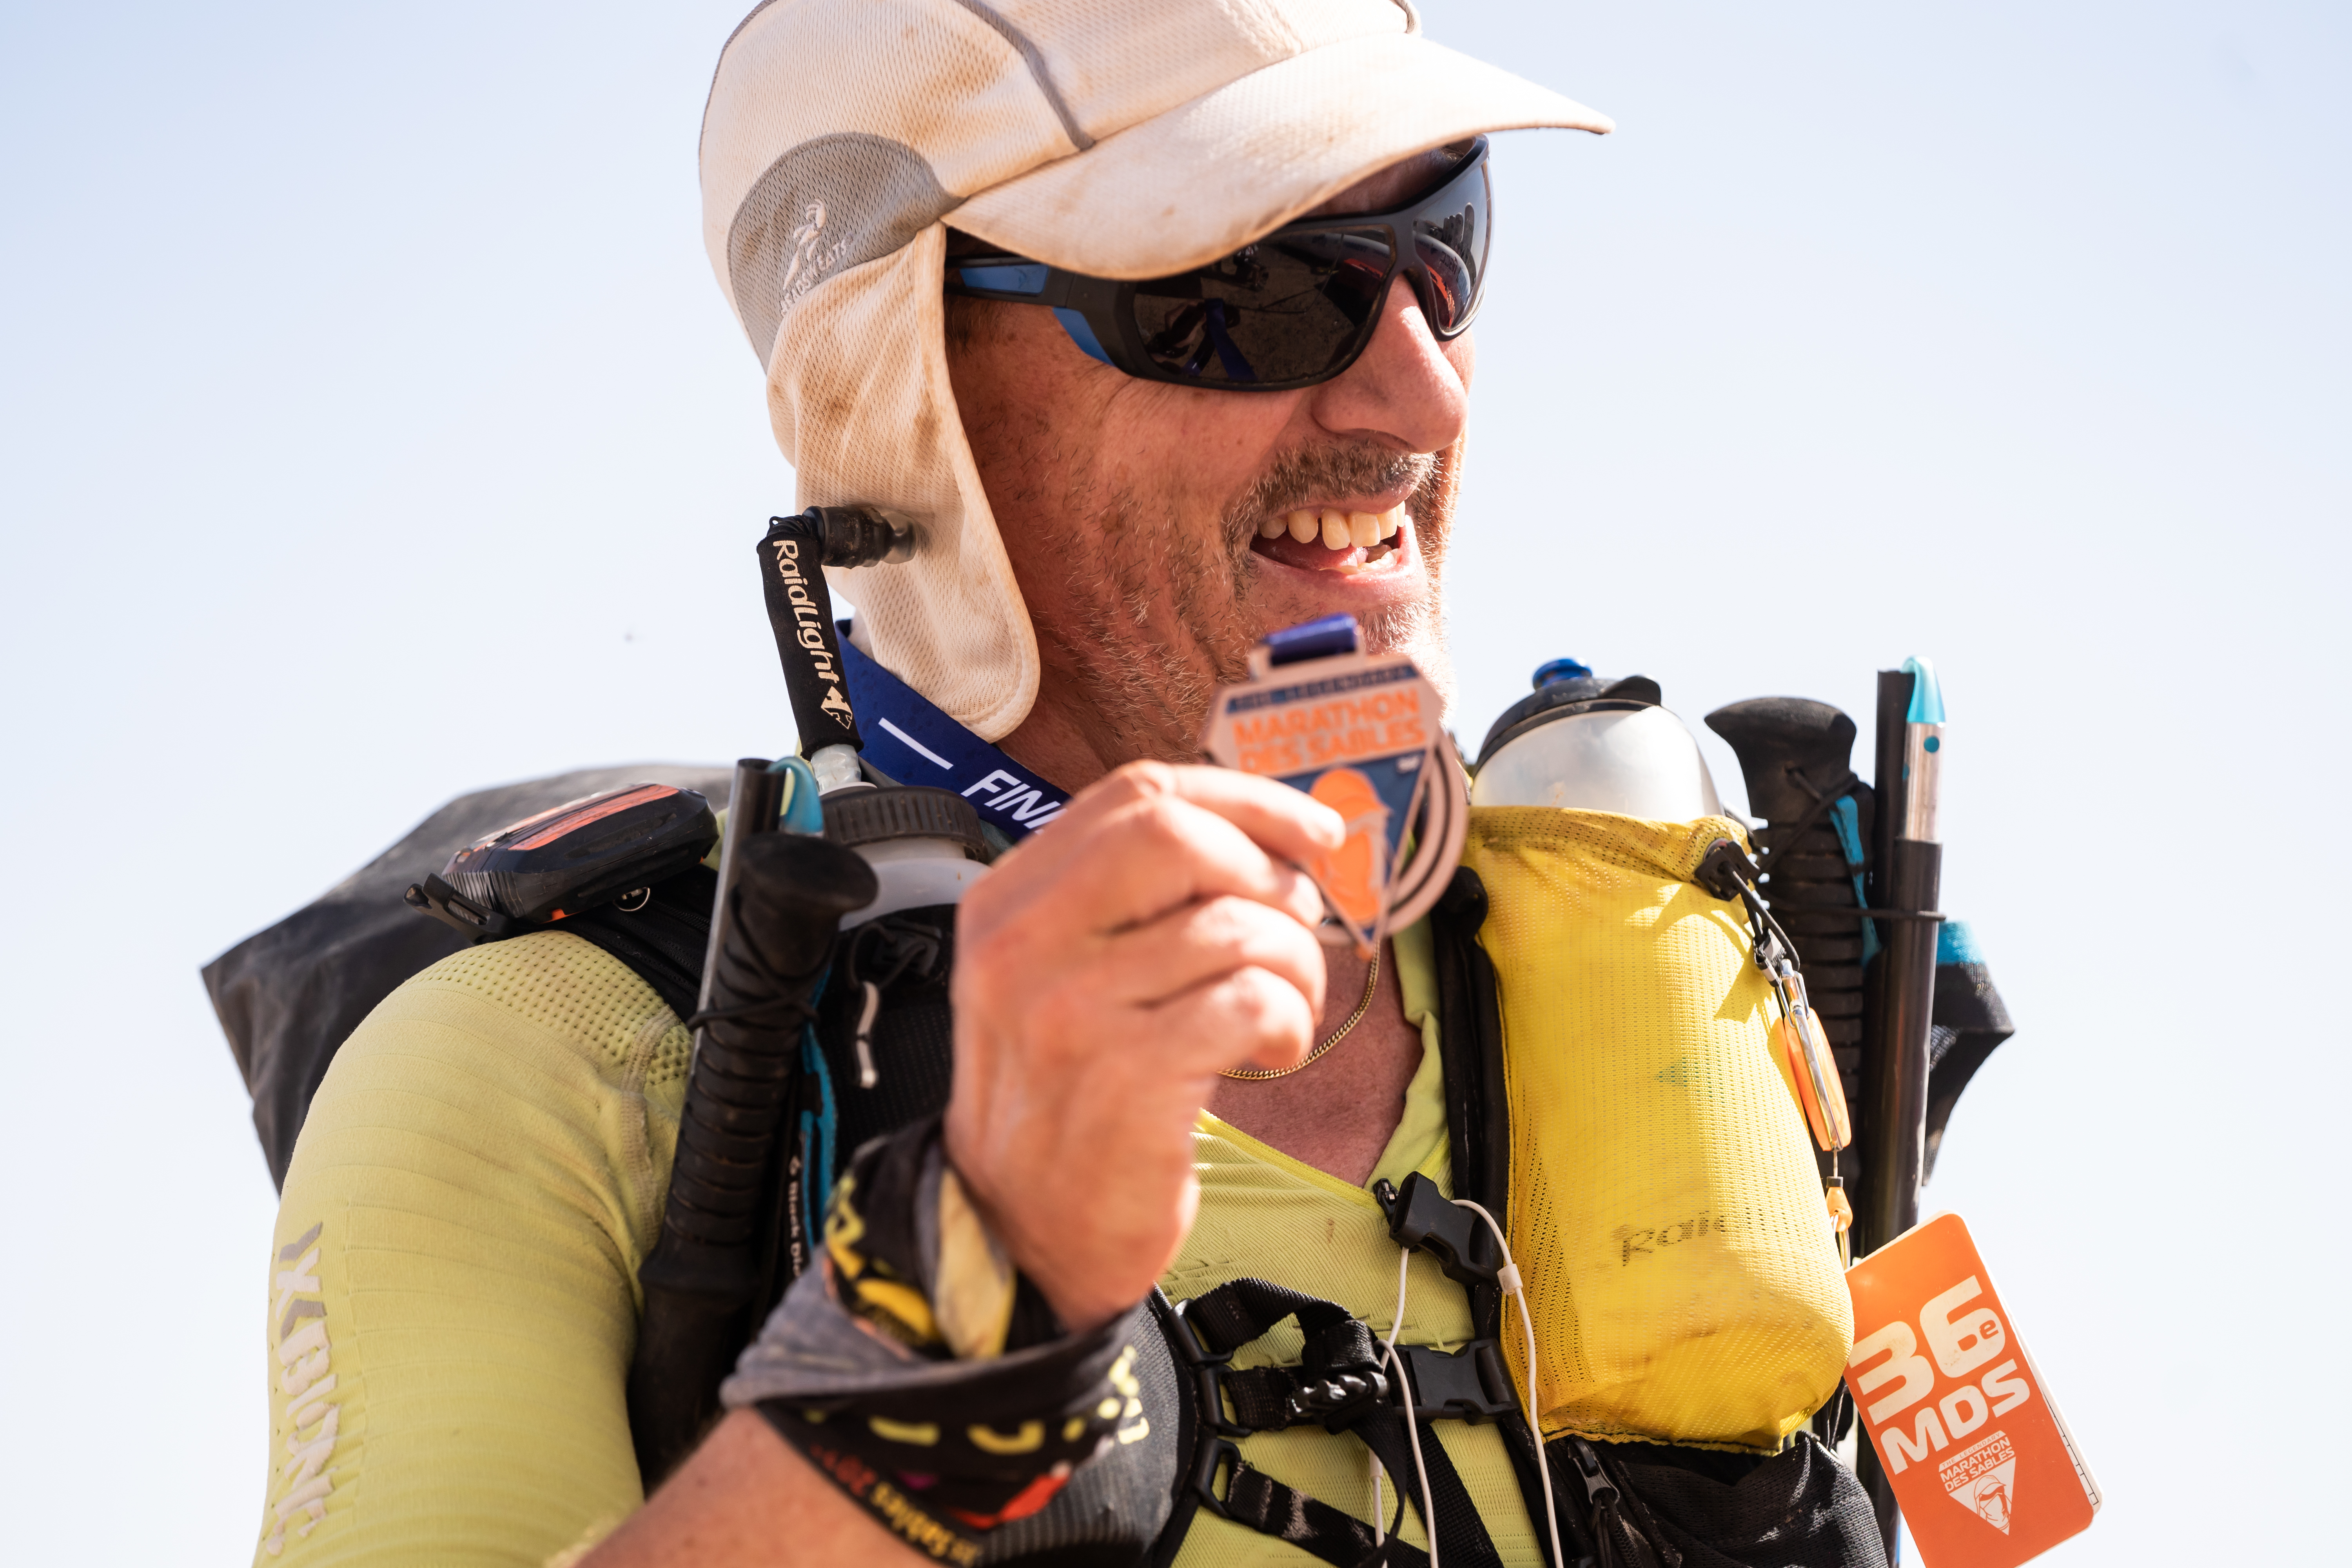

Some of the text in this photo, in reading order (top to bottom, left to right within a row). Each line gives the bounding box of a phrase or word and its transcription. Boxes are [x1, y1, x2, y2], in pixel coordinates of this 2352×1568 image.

[773, 540, 839, 684] RaidLight
[1234, 689, 1419, 746] MARATHON
[1880, 1359, 2030, 1475] MDS
[1940, 1436, 2011, 1483] MARATHON
[1942, 1432, 2001, 1468] THE LEGENDARY
[1945, 1448, 2015, 1492] DES SABLES
